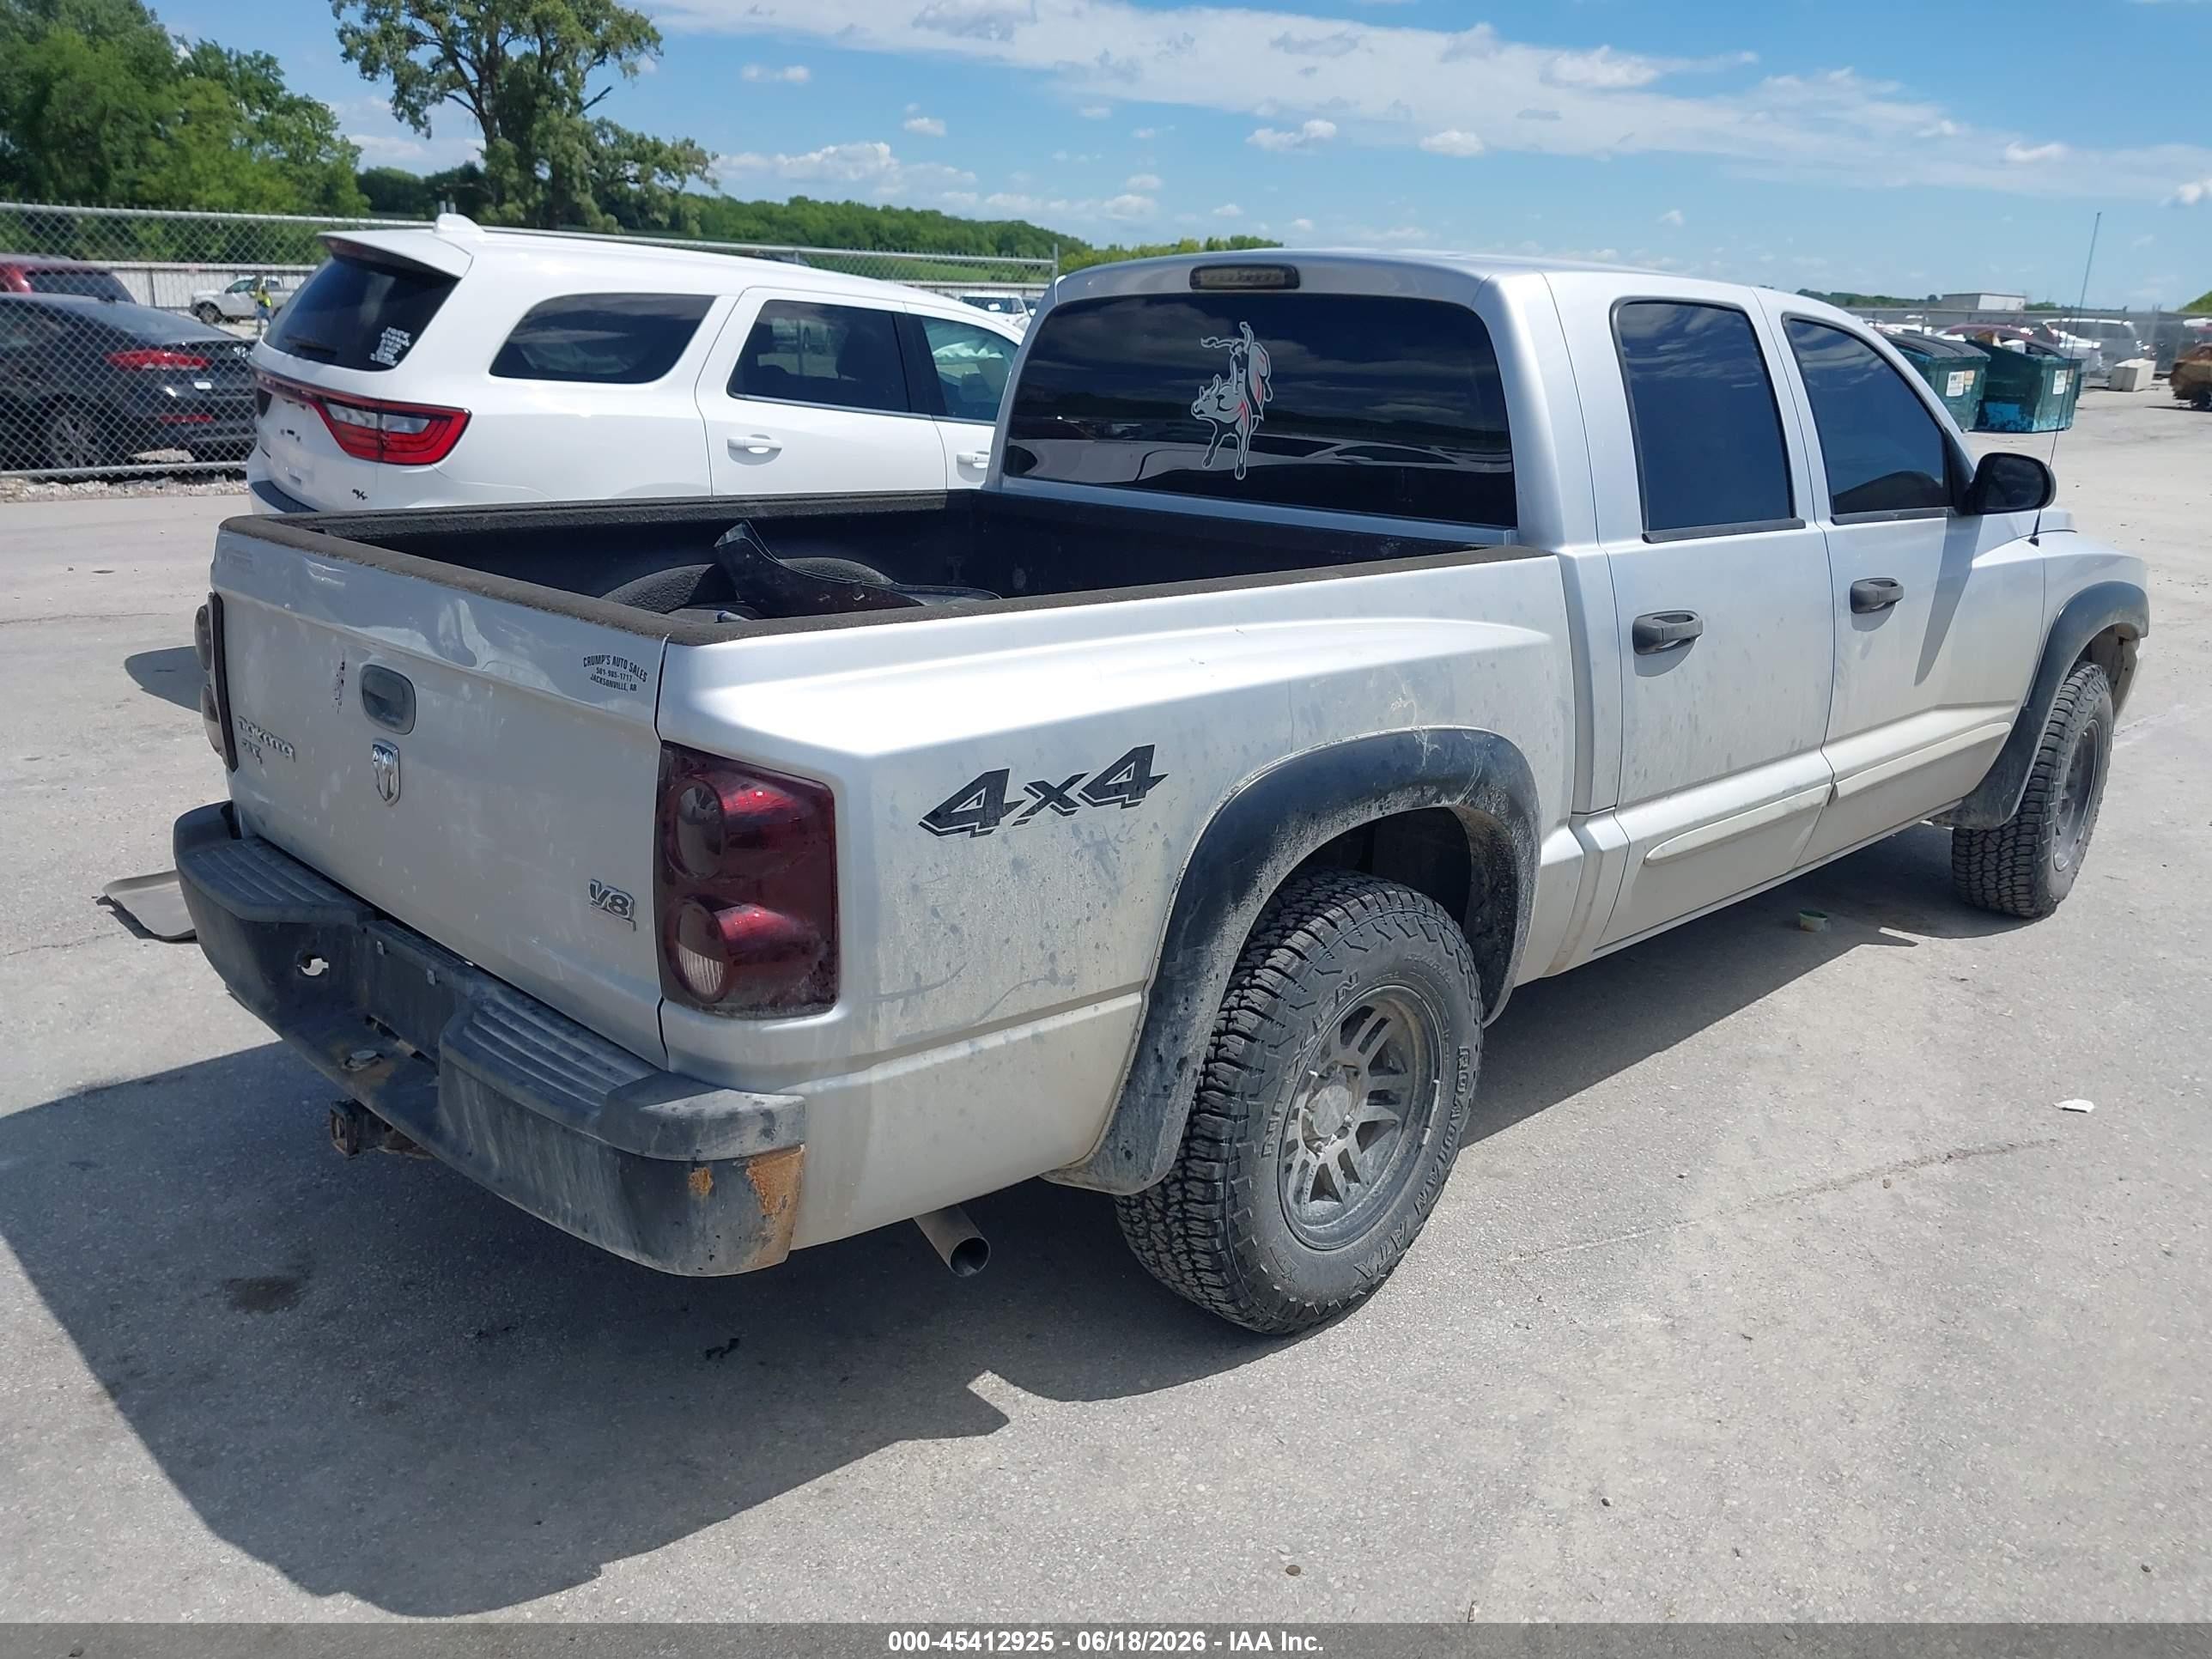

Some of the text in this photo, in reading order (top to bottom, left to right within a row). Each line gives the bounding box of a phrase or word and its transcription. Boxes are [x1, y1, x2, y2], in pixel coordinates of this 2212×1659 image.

[583, 654, 647, 682] CRUMP'S AUTO SALES
[917, 744, 1170, 839] 4x4
[589, 878, 635, 921] V8
